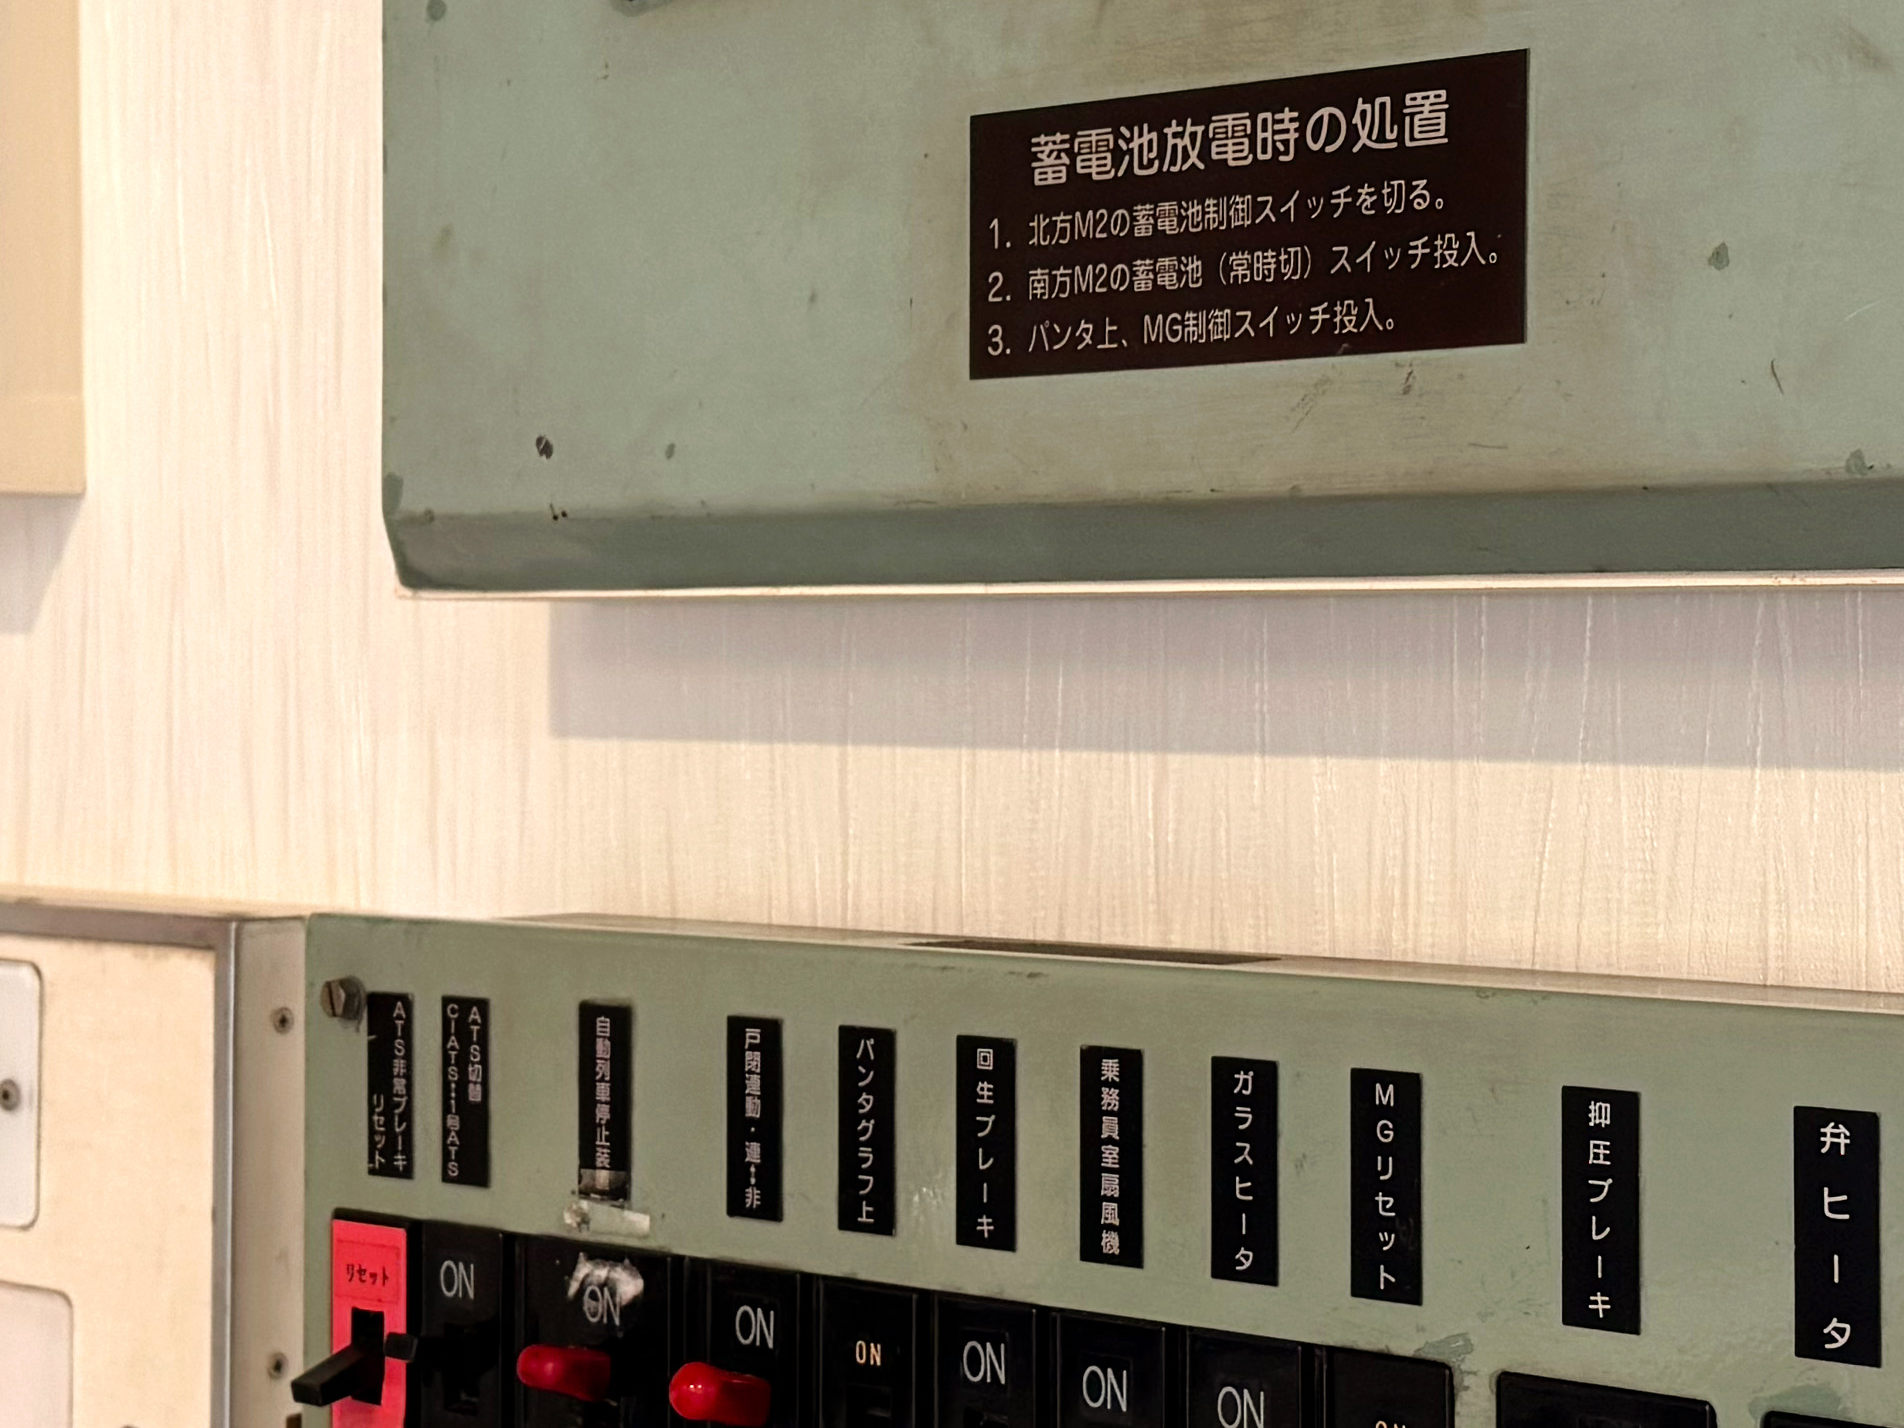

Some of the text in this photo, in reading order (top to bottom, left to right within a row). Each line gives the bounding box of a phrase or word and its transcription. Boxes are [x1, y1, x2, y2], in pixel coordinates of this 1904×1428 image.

[1031, 89, 1449, 186] 蓄電池放電時の処置
[371, 1093, 387, 1170] リセット
[595, 1015, 612, 1191] 自動列車停止装
[856, 1038, 875, 1223] パンタグラフ上
[975, 1046, 996, 1239] 回生ブレーキ
[1100, 1058, 1121, 1257] 乗務員室扇風機
[1233, 1071, 1255, 1272] ガラスヒータ
[1374, 1083, 1397, 1292] MGリセット
[1586, 1098, 1613, 1320] 抑圧ブレーキ
[1819, 1123, 1852, 1350] 弁ヒータ
[346, 1263, 389, 1287] リセット
[439, 1259, 475, 1300] ON
[582, 1285, 621, 1328] ON
[735, 1304, 775, 1350] ON
[855, 1339, 882, 1368] ON
[962, 1339, 1007, 1386] ON
[1082, 1364, 1128, 1413] ON
